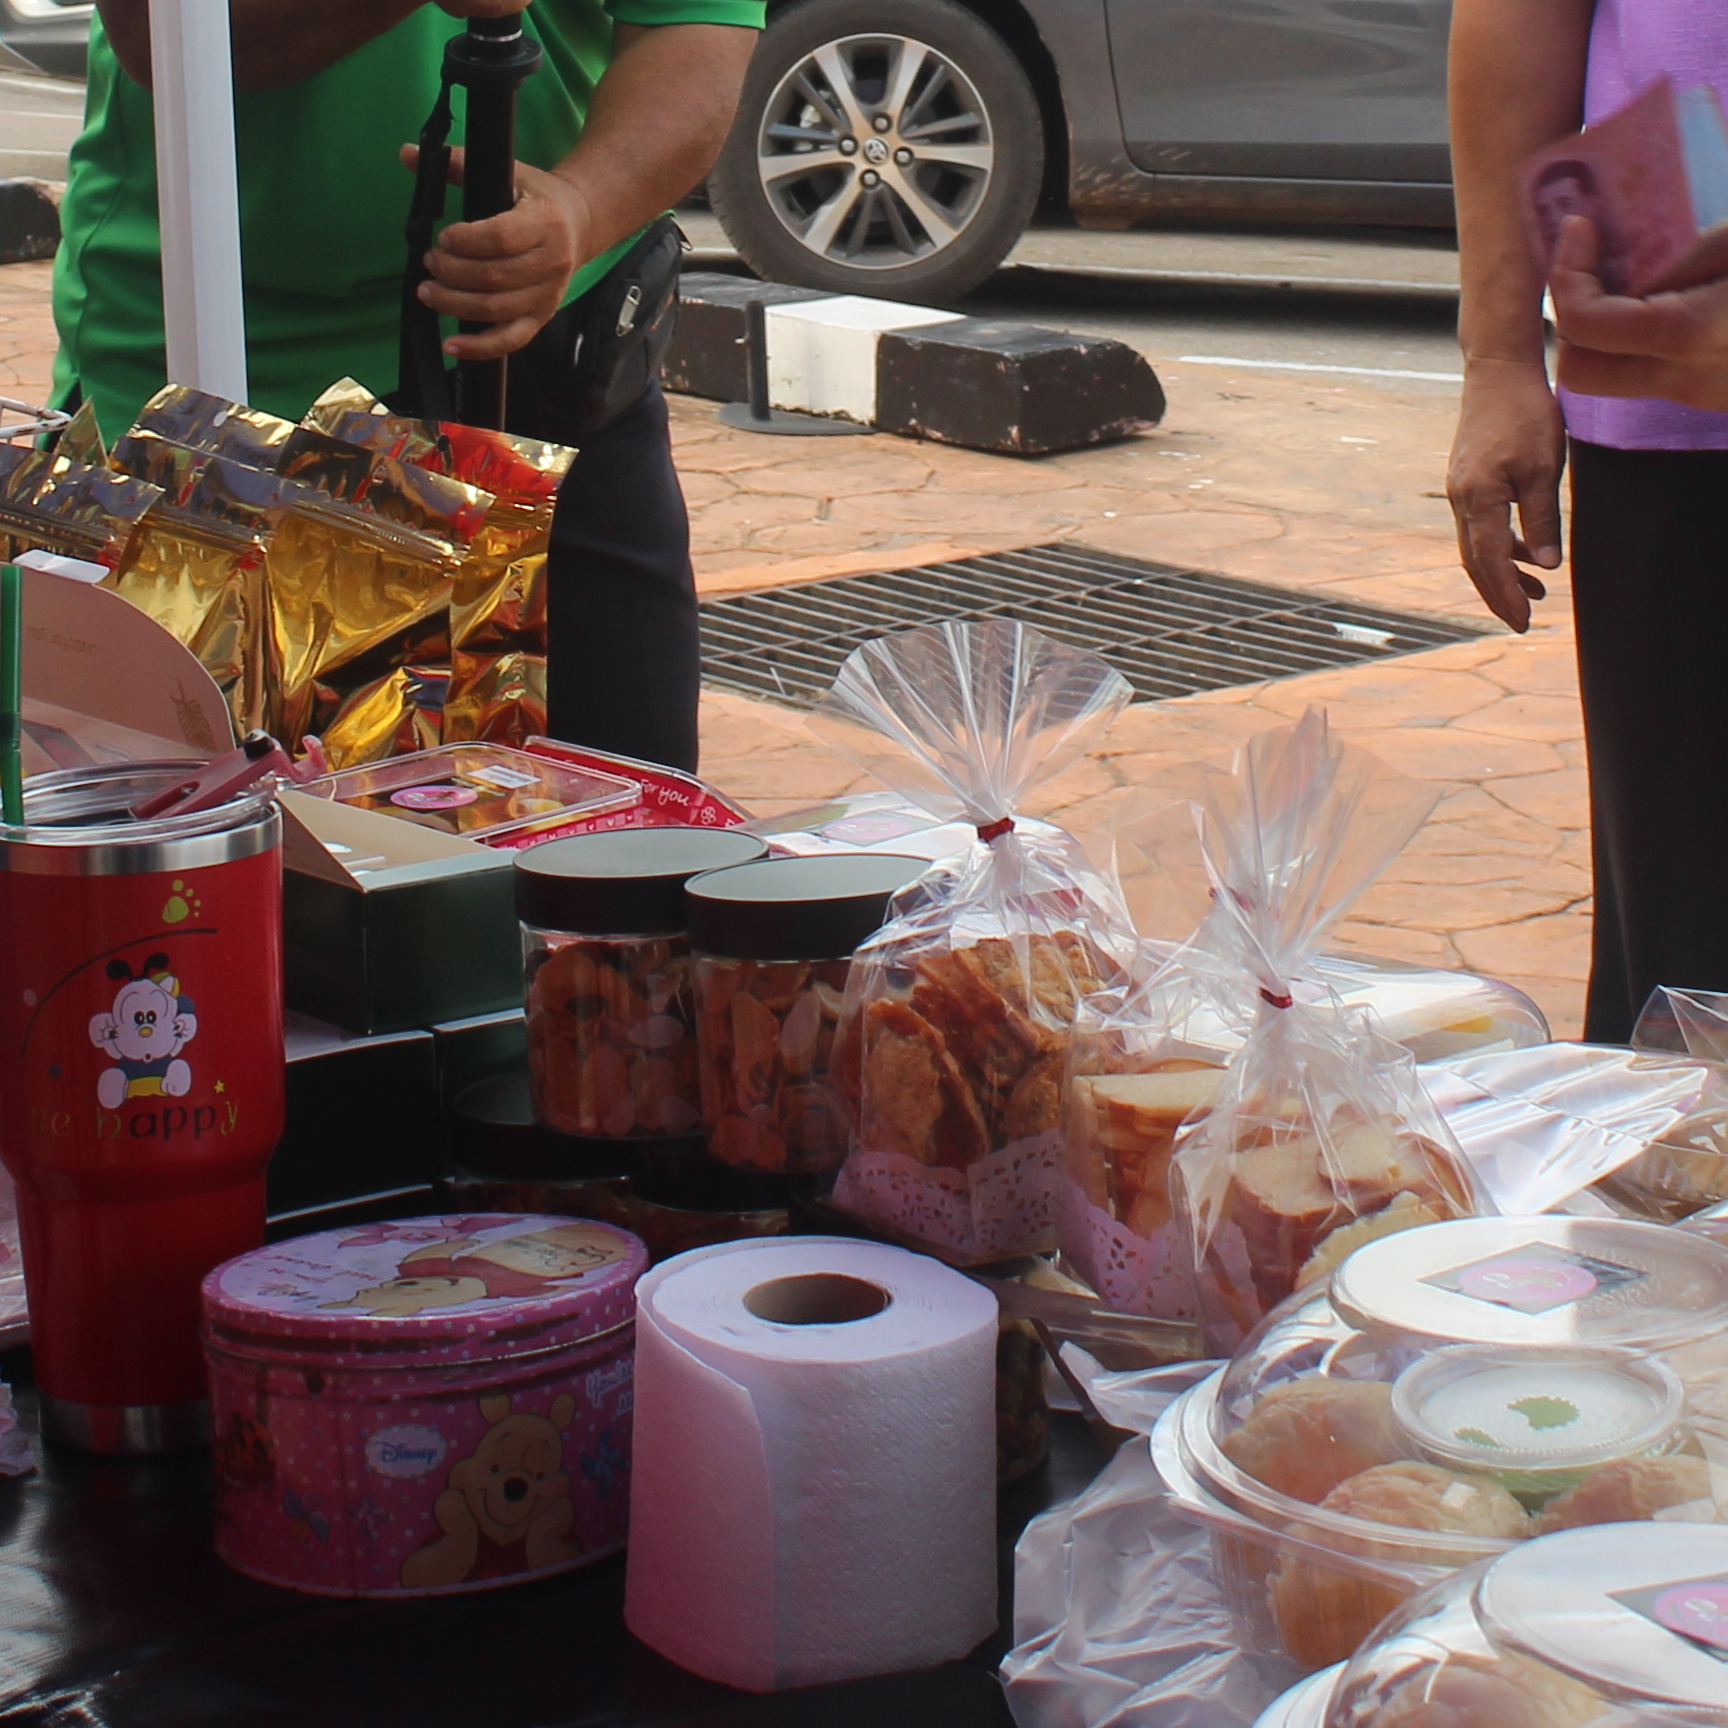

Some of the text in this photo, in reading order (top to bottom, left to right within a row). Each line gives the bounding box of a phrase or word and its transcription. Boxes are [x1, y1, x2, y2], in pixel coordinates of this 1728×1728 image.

[658, 787, 690, 807] you
[95, 1100, 239, 1141] happy
[373, 1440, 438, 1465] Disney
